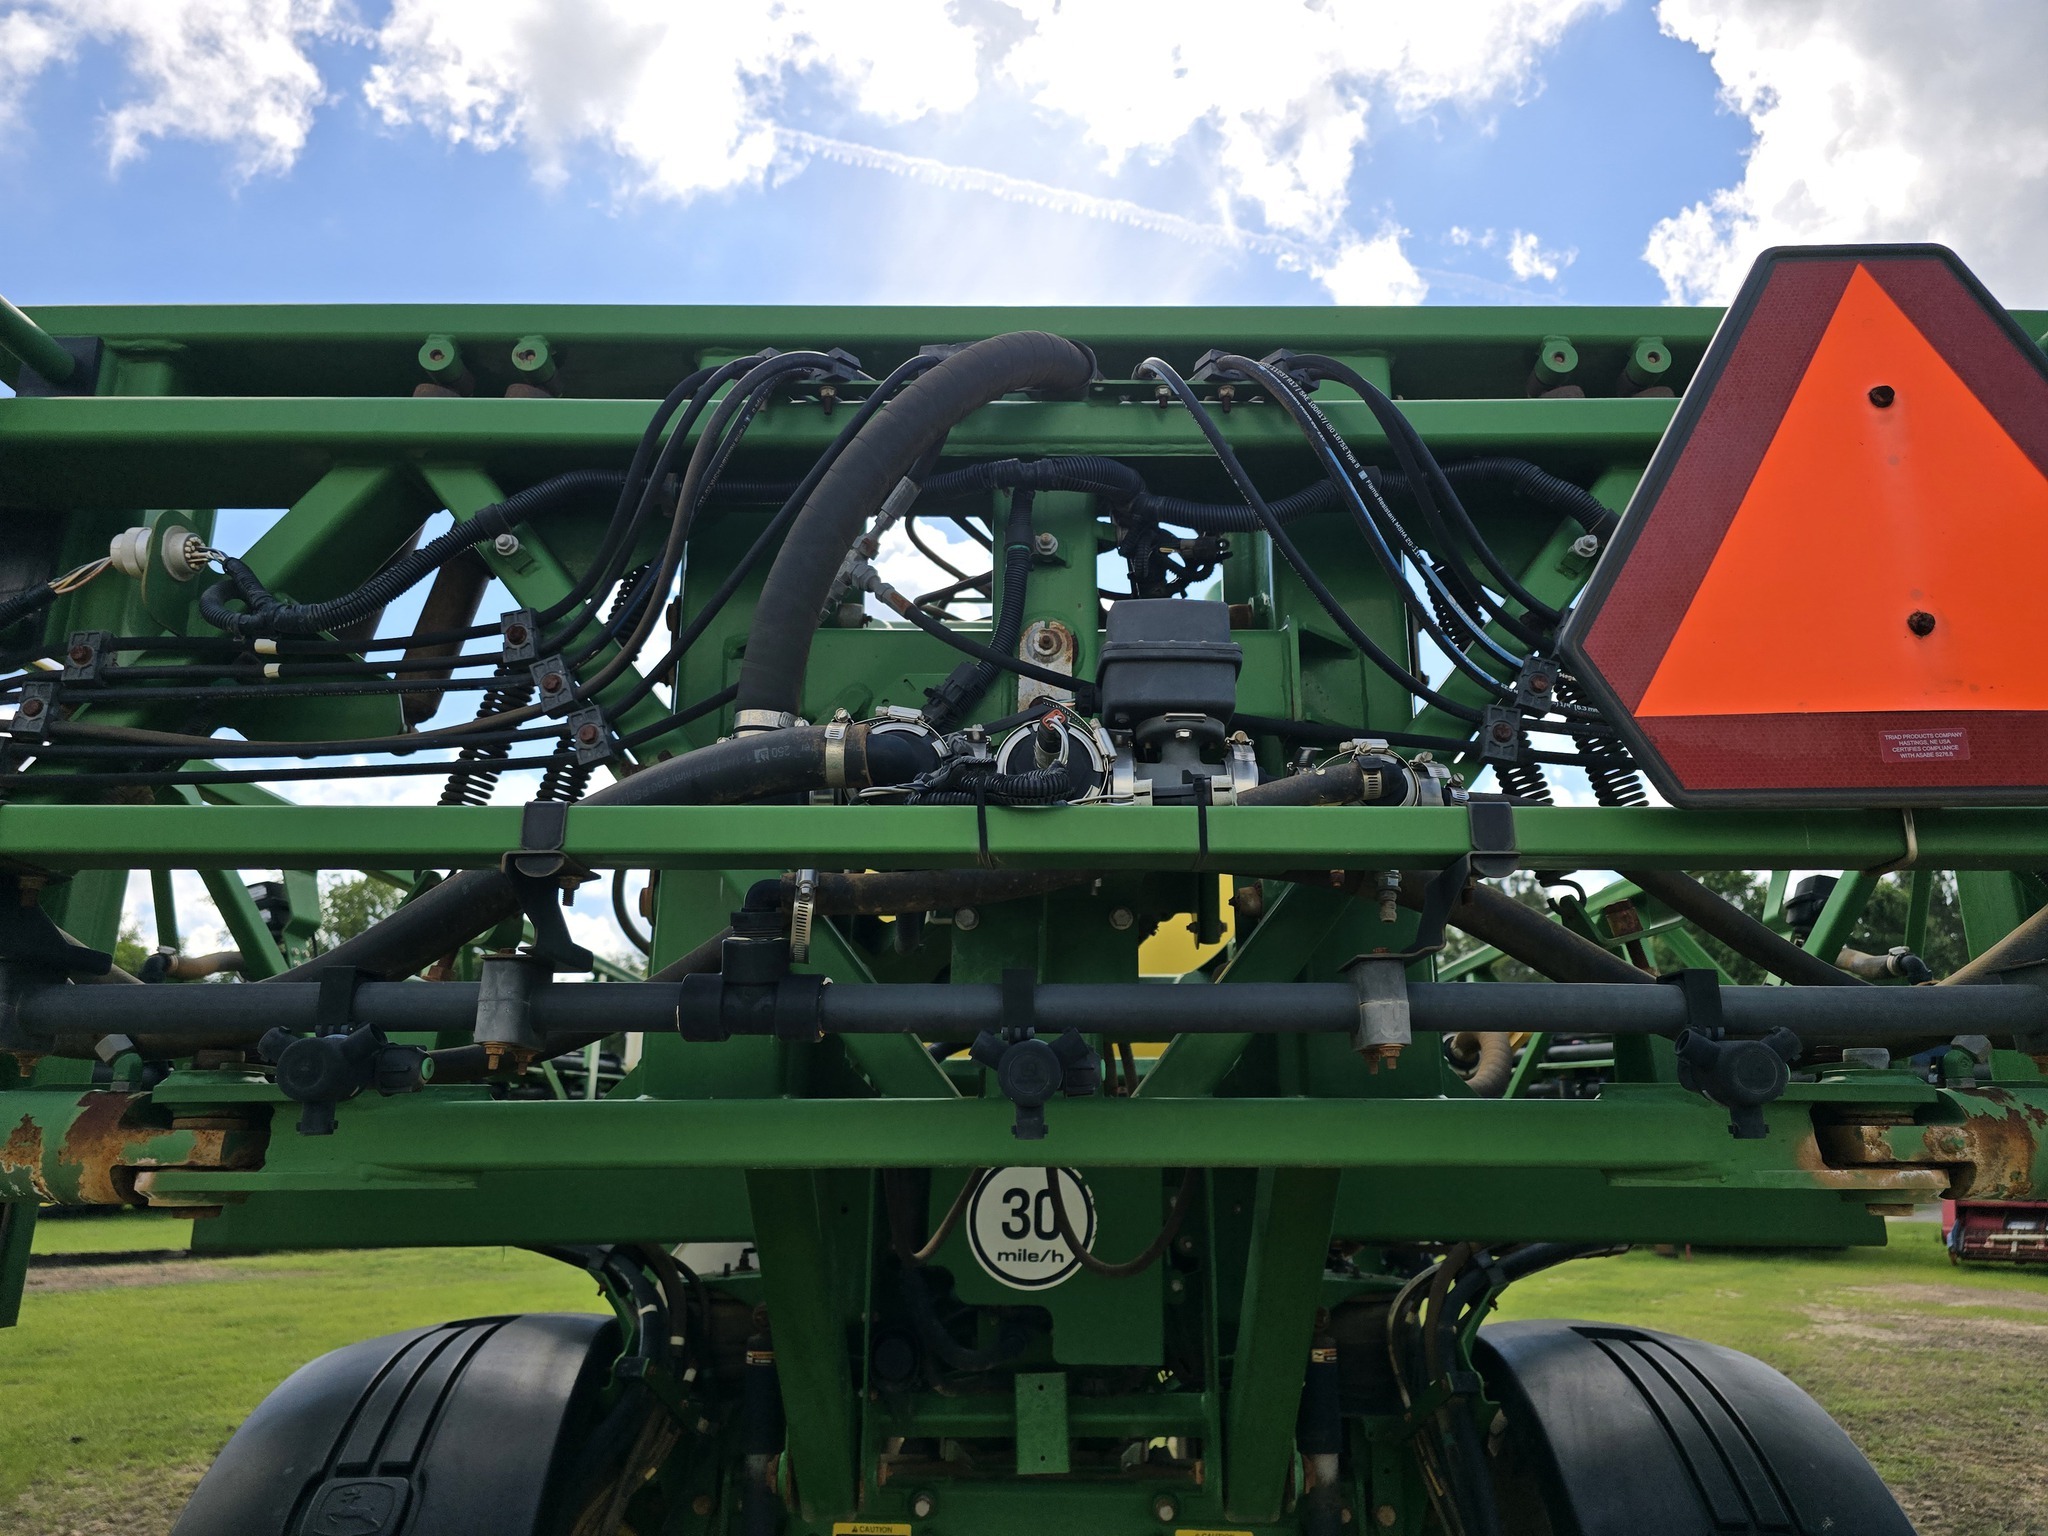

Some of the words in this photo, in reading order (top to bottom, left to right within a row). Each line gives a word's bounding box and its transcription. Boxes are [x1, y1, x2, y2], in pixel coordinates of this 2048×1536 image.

[1287, 378, 1298, 388] R17
[1299, 391, 1310, 402] SAE
[1345, 450, 1358, 464] Type
[1365, 479, 1380, 497] Flame
[1376, 496, 1397, 523] Resistant
[1394, 522, 1408, 539] MSHA
[772, 745, 790, 758] 250
[1002, 1188, 1060, 1240] 30
[997, 1248, 1064, 1263] mile/h
